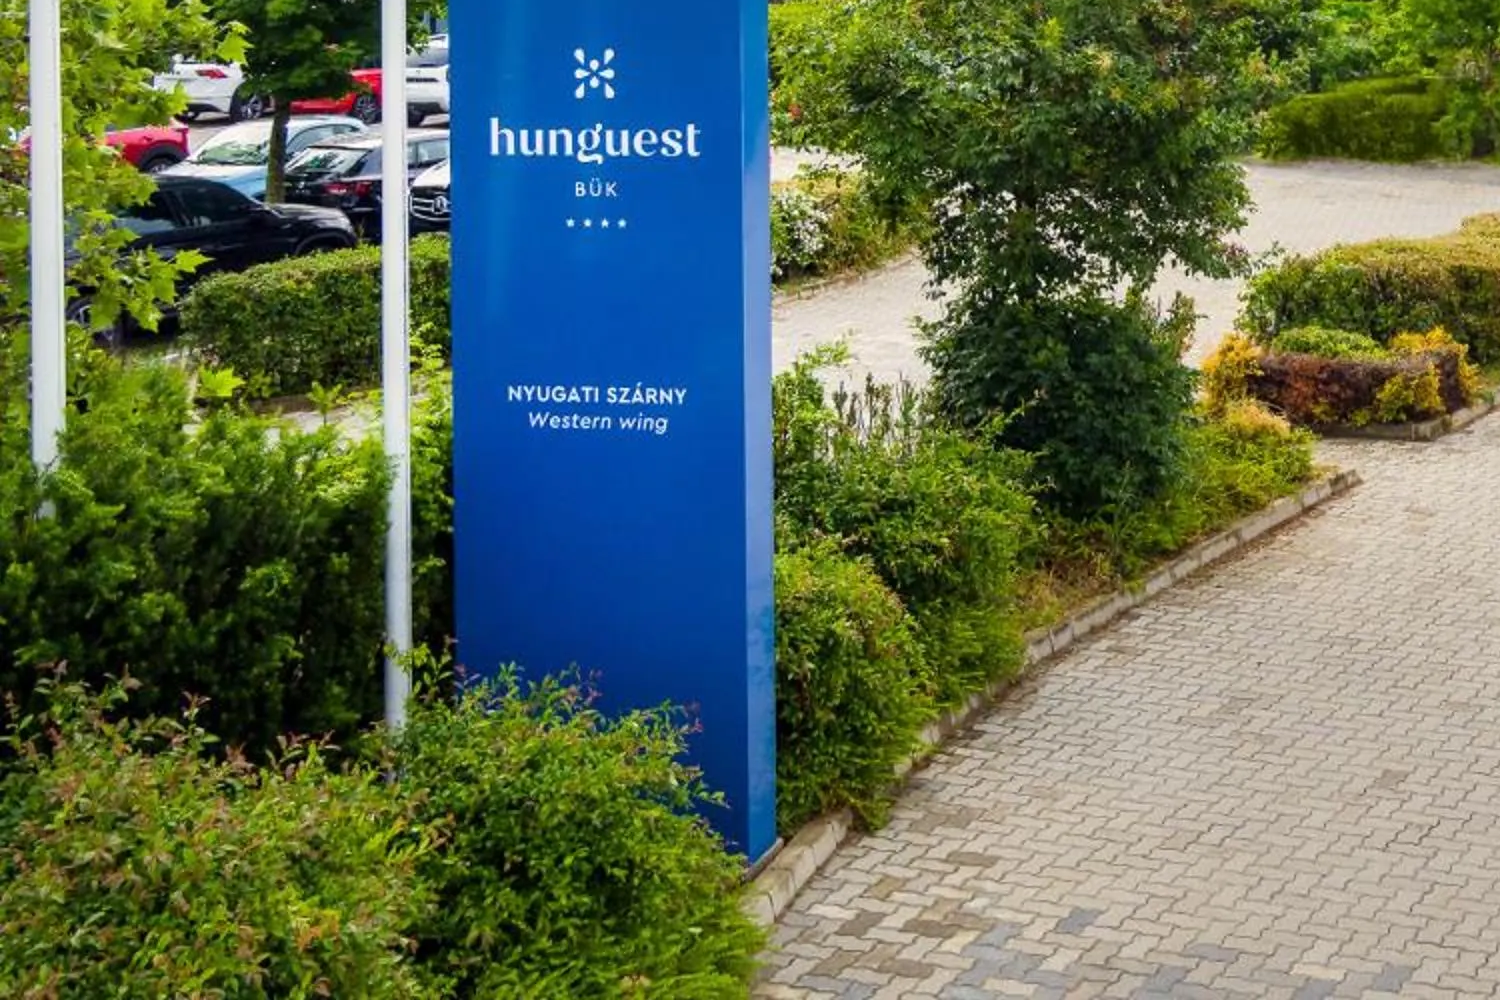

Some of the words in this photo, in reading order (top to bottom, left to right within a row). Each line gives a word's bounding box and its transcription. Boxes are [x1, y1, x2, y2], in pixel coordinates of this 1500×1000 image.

[489, 117, 701, 165] hunguest
[575, 178, 618, 198] BÜK
[508, 385, 600, 403] NYUGATI
[606, 382, 687, 405] SZÁRNY
[528, 411, 612, 430] Western
[619, 413, 669, 435] wing
